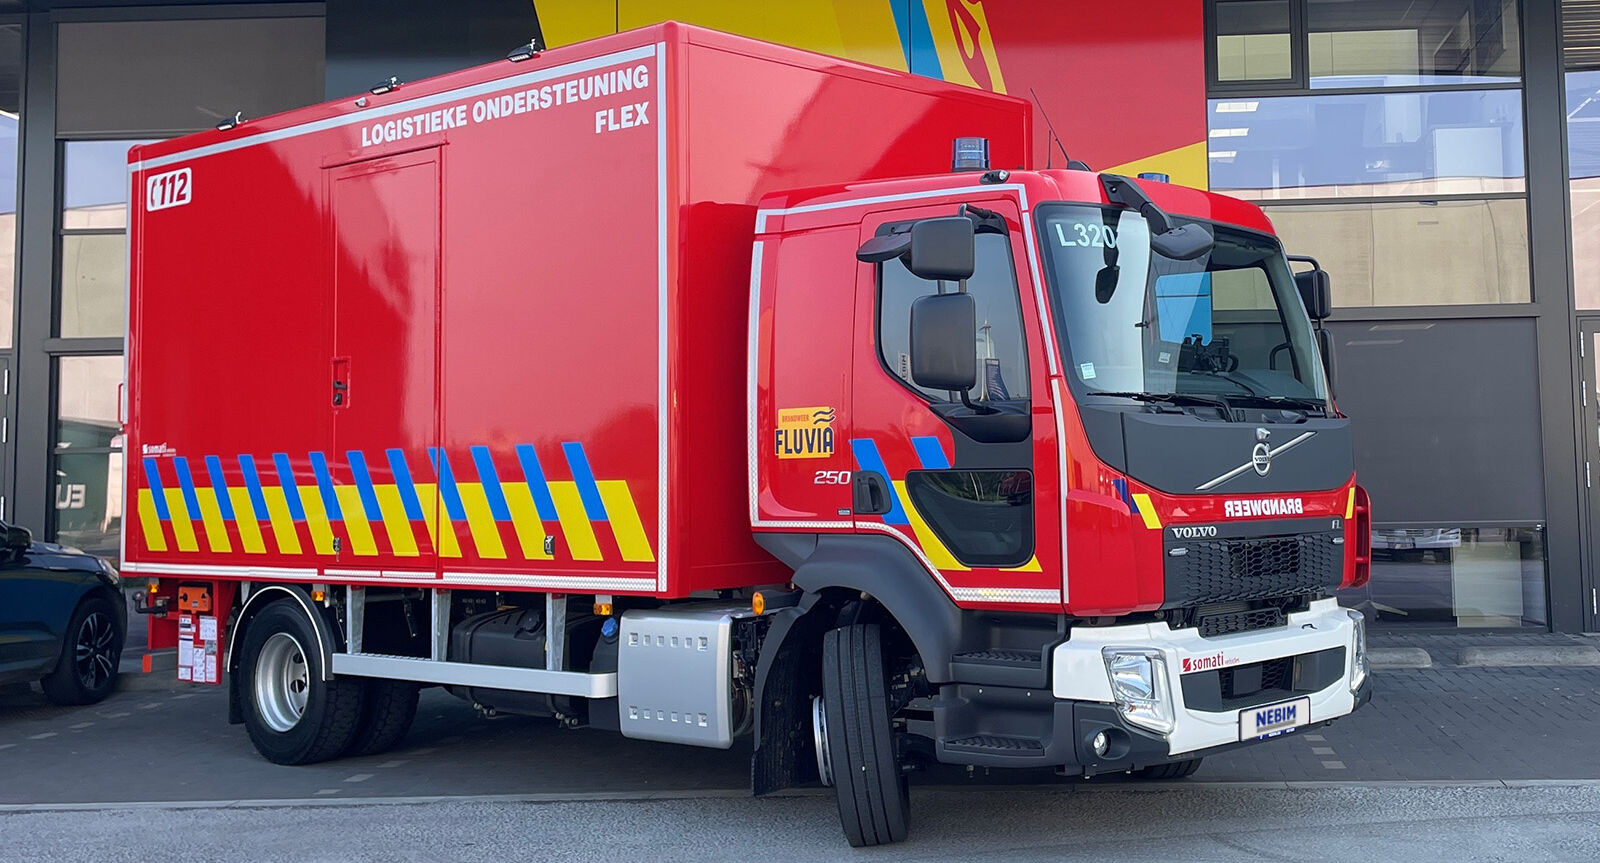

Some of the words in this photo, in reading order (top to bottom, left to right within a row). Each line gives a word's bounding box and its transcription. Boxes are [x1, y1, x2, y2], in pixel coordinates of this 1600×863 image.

[361, 106, 467, 147] LOGISTIEKE
[473, 65, 649, 123] ONDERSTEUNING
[595, 102, 649, 134] FLEX
[160, 172, 188, 205] 112
[775, 427, 834, 454] FLUVIA
[814, 470, 851, 484] 250
[1172, 526, 1217, 538] VOLVO
[1193, 651, 1224, 671] somati
[1256, 704, 1297, 727] NEBIM
